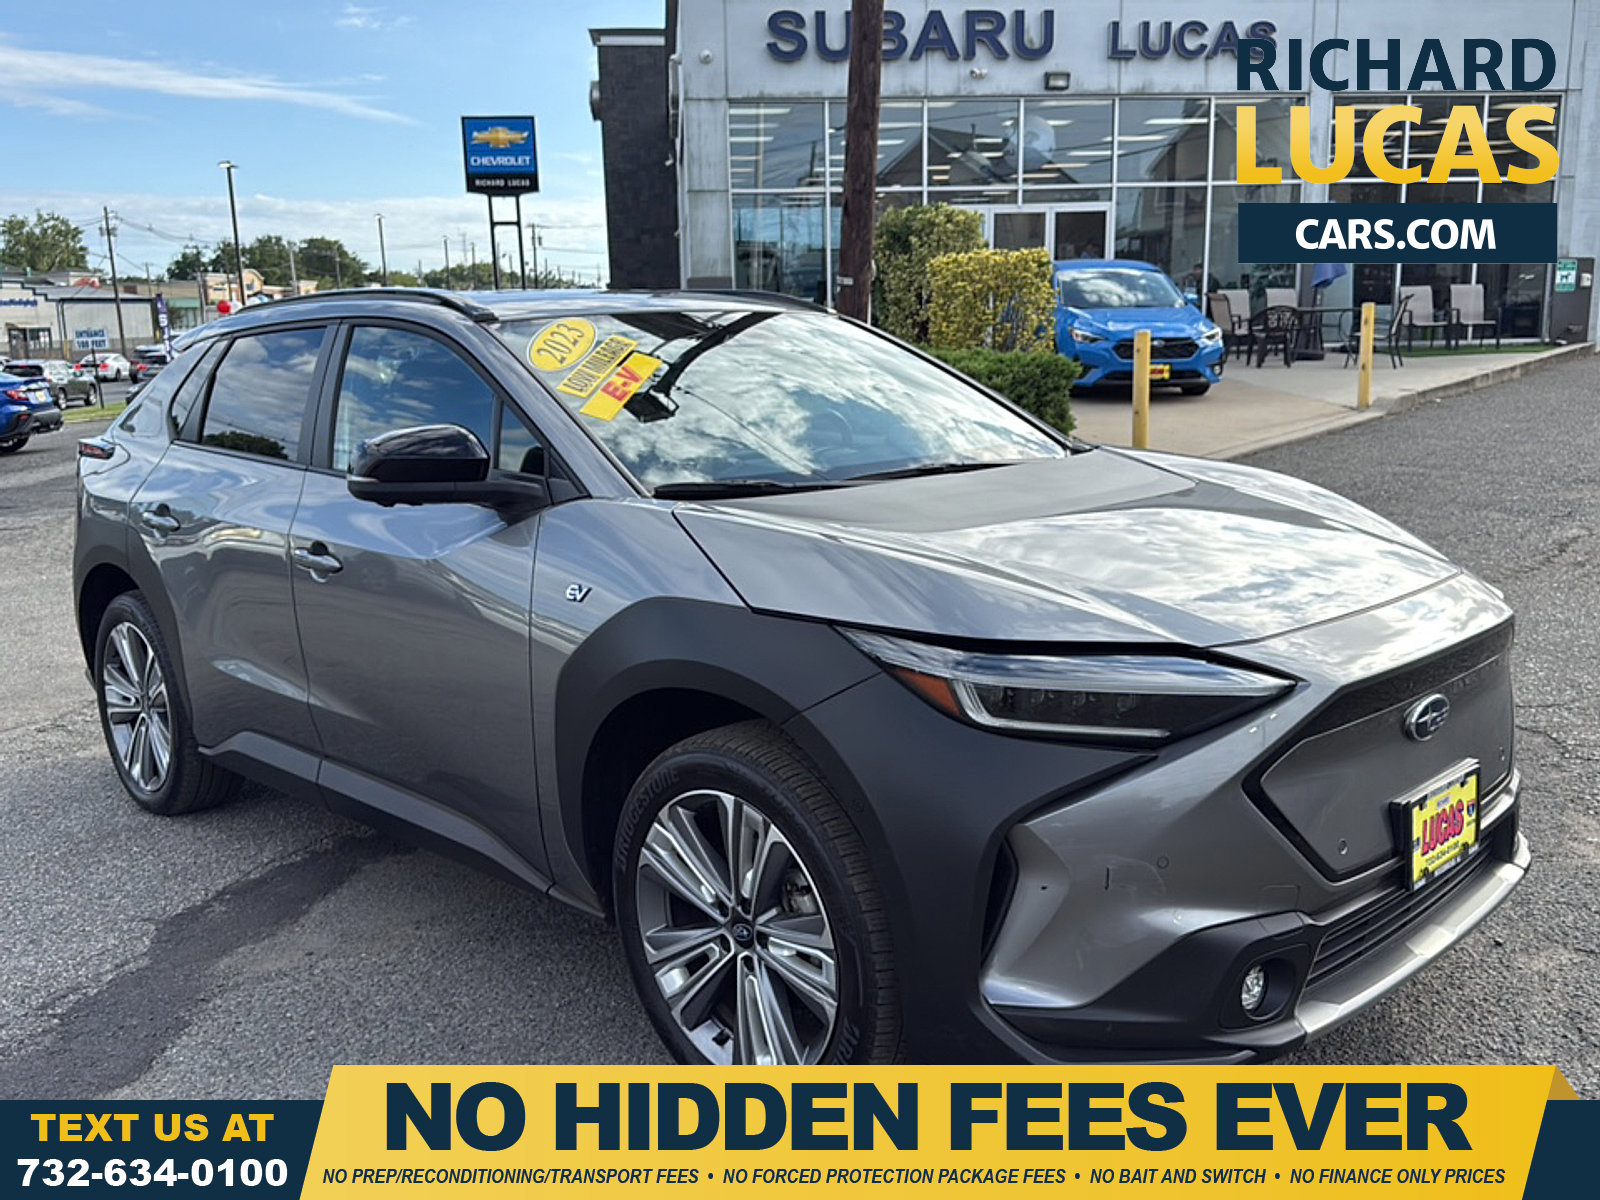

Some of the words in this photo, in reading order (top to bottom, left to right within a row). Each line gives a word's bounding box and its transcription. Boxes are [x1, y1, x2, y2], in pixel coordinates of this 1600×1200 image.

[766, 9, 1055, 61] SUBARU
[1108, 20, 1278, 59] LUCAS
[470, 155, 531, 167] CHEVROLET
[475, 178, 506, 187] RICHARD
[507, 178, 531, 187] LUCAS
[536, 323, 584, 364] 2023
[600, 364, 642, 402] E-V
[1421, 798, 1465, 856] LUCAS
